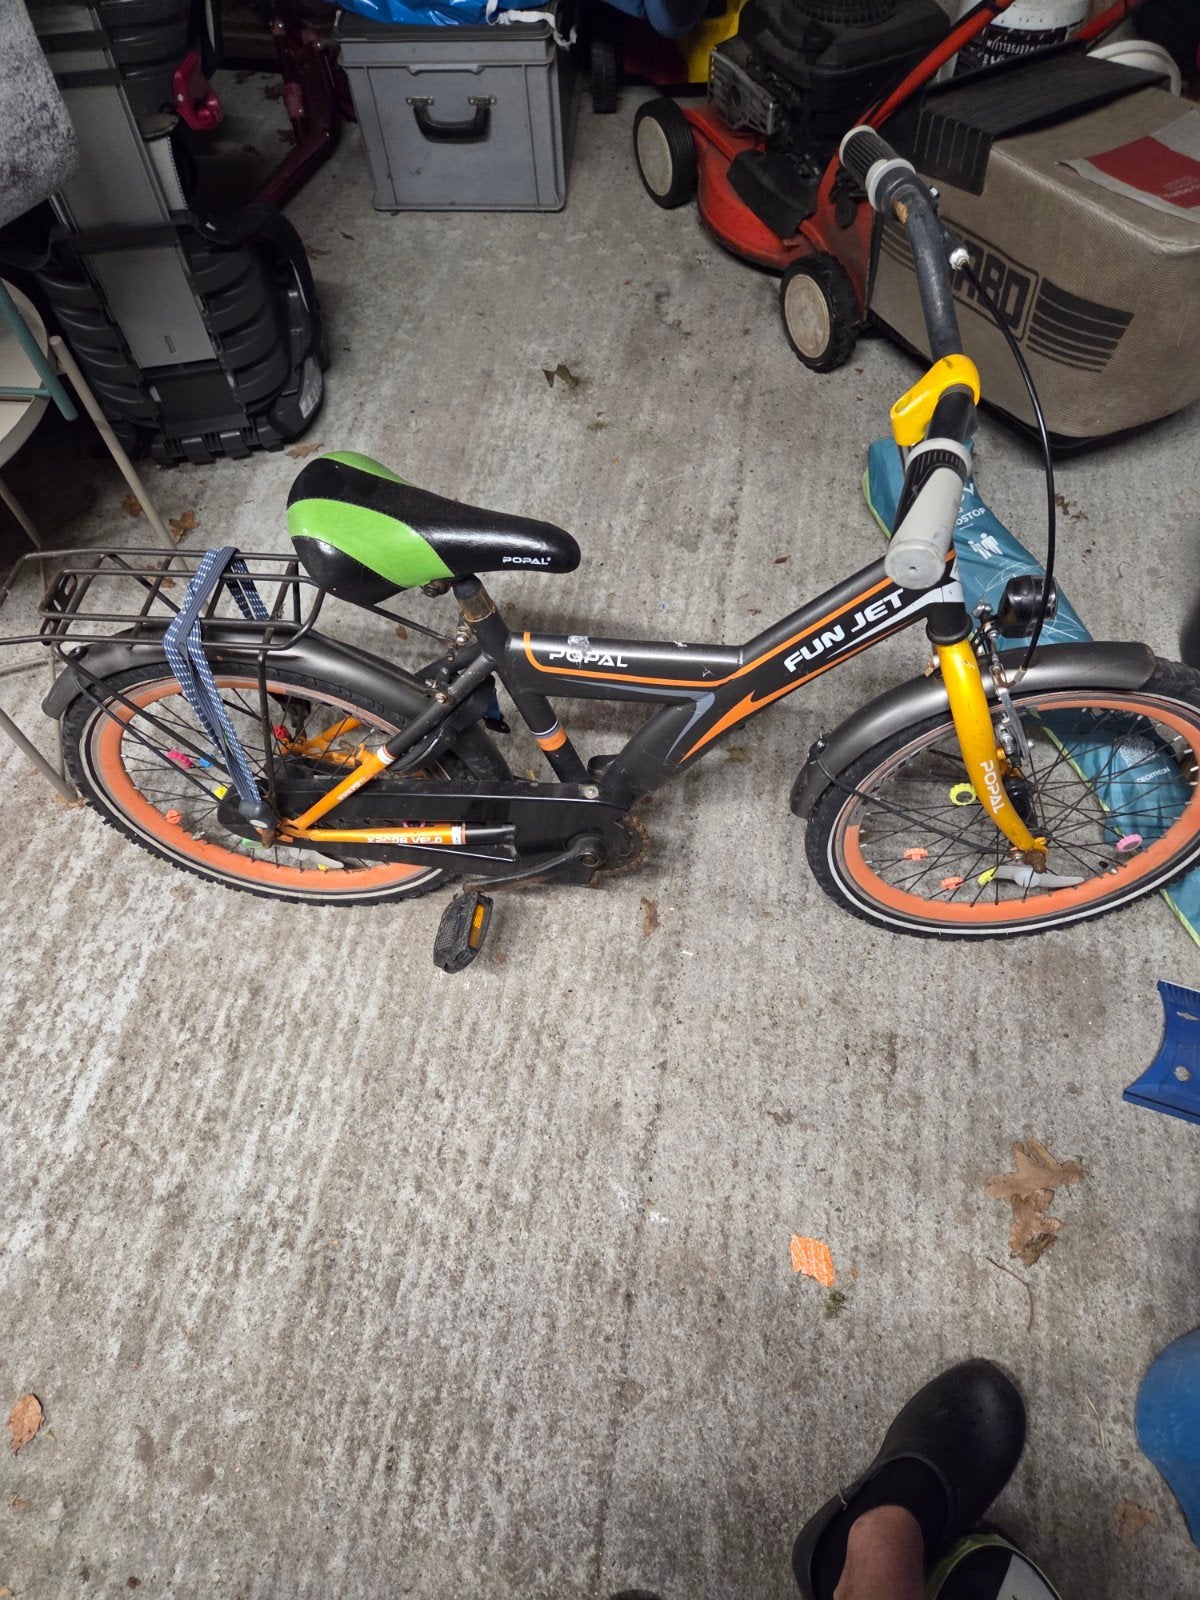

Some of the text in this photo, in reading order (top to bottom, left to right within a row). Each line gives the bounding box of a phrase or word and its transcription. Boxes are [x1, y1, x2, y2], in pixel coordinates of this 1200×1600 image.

[950, 238, 1031, 330] ABO
[955, 507, 986, 526] OSTOP
[502, 556, 549, 565] POPAL
[783, 587, 904, 673] FUN JET
[549, 650, 629, 668] POPAL
[980, 759, 1005, 814] POPAL
